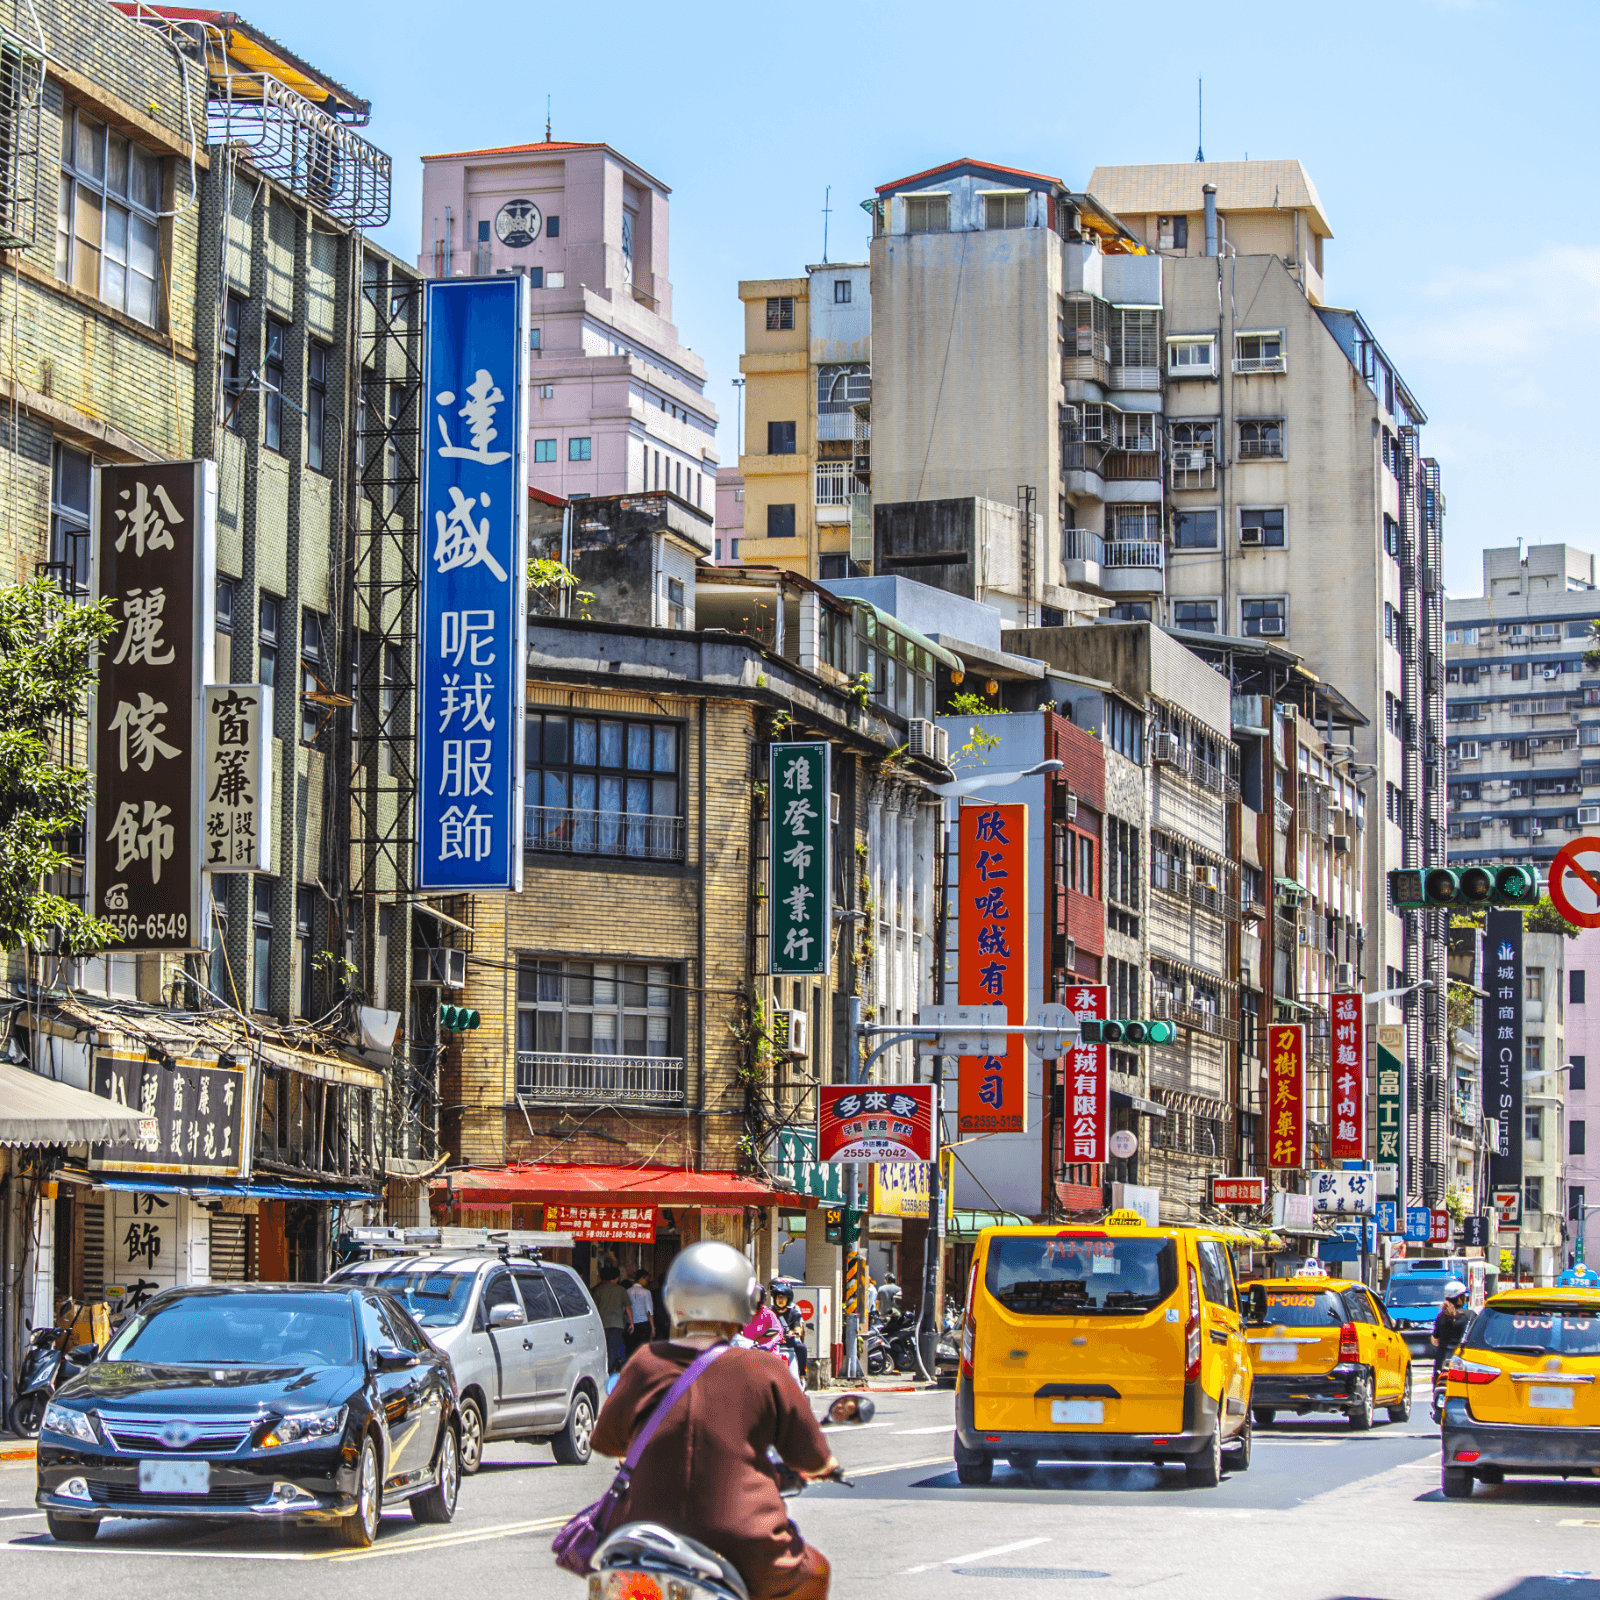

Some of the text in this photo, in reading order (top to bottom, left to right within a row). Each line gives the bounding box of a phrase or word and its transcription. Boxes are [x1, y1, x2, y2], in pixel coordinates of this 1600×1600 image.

[105, 481, 184, 885] 淞麗傢飾
[206, 812, 230, 865] 施工
[235, 811, 256, 864] 設計
[782, 756, 818, 961] 雅登布業行
[974, 810, 1010, 1109] 欣仁呢絨有公司
[1497, 966, 1514, 1039] 城市商旅
[840, 1091, 916, 1118] 多來家
[974, 1116, 1022, 1128] 2559-5159
[843, 1148, 907, 1158] 2555-9042
[827, 1210, 841, 1224] 54
